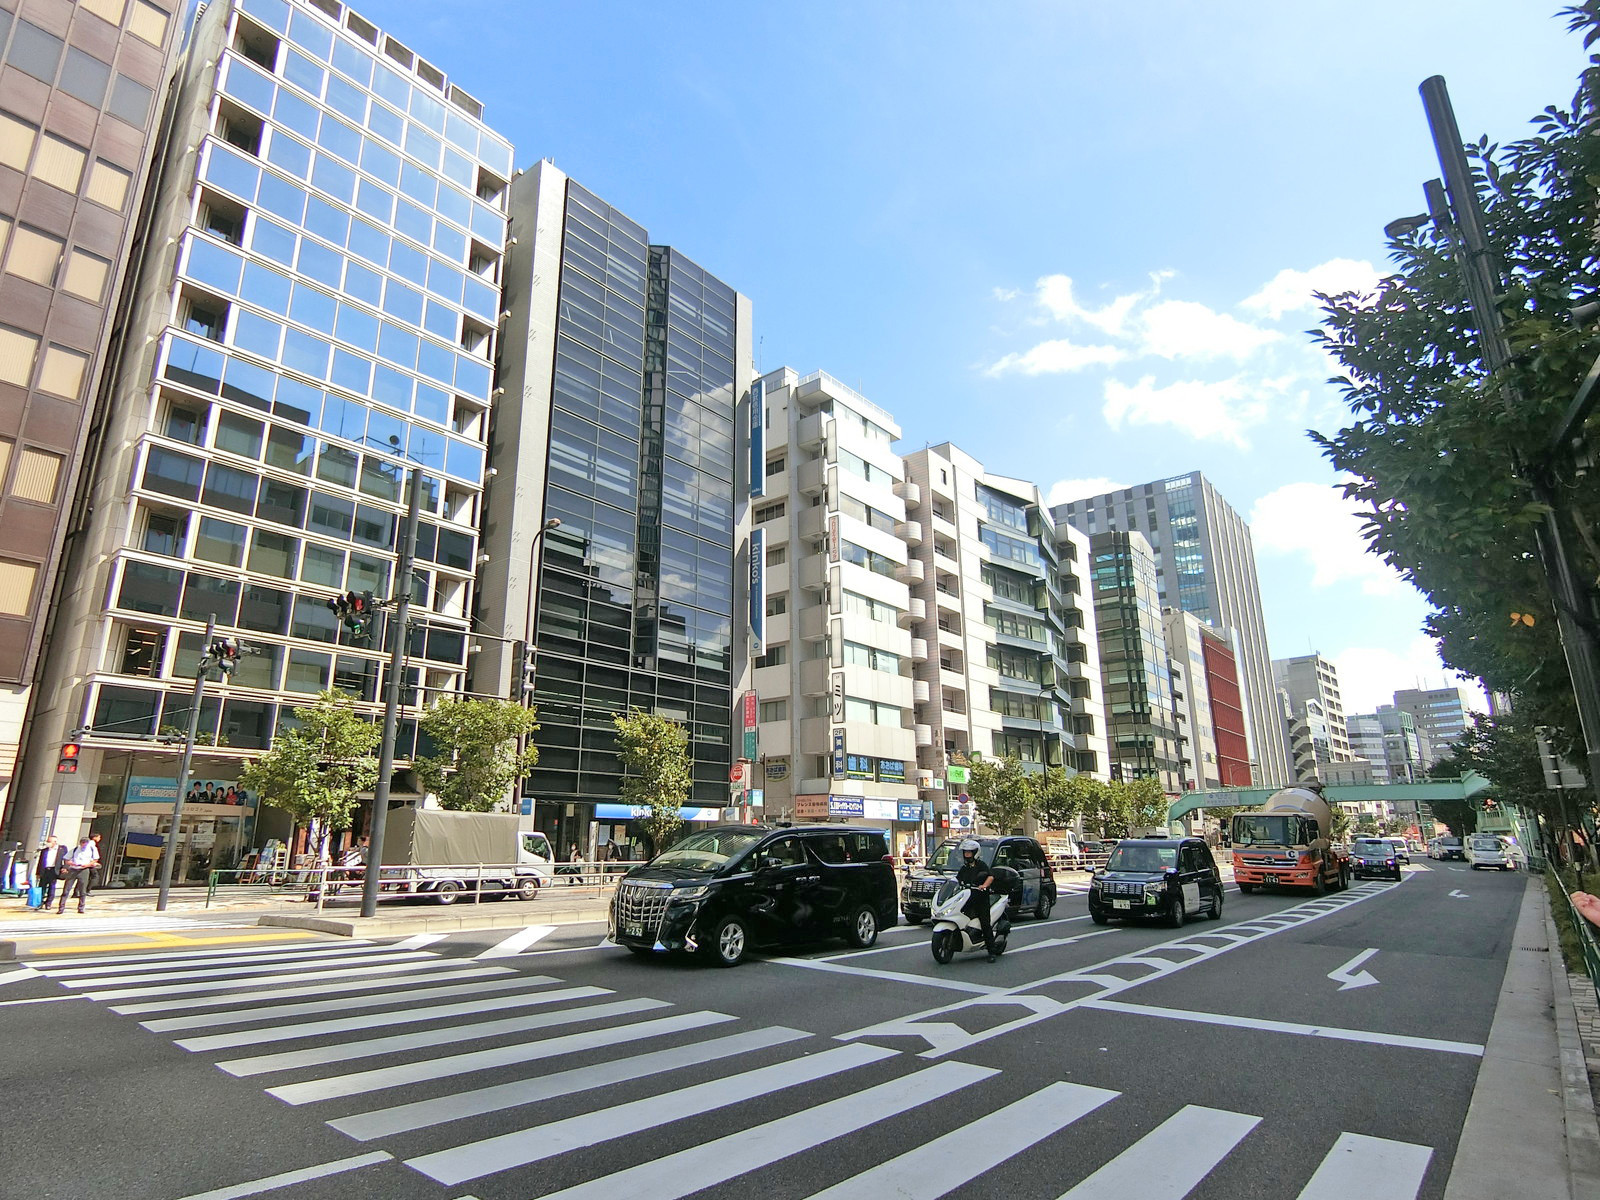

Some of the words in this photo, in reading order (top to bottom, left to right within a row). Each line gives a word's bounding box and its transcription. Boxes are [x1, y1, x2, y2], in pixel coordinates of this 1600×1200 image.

[751, 542, 761, 584] kinko's
[834, 684, 842, 716] ミツ
[848, 756, 868, 772] 歯科
[1289, 850, 1296, 858] C
